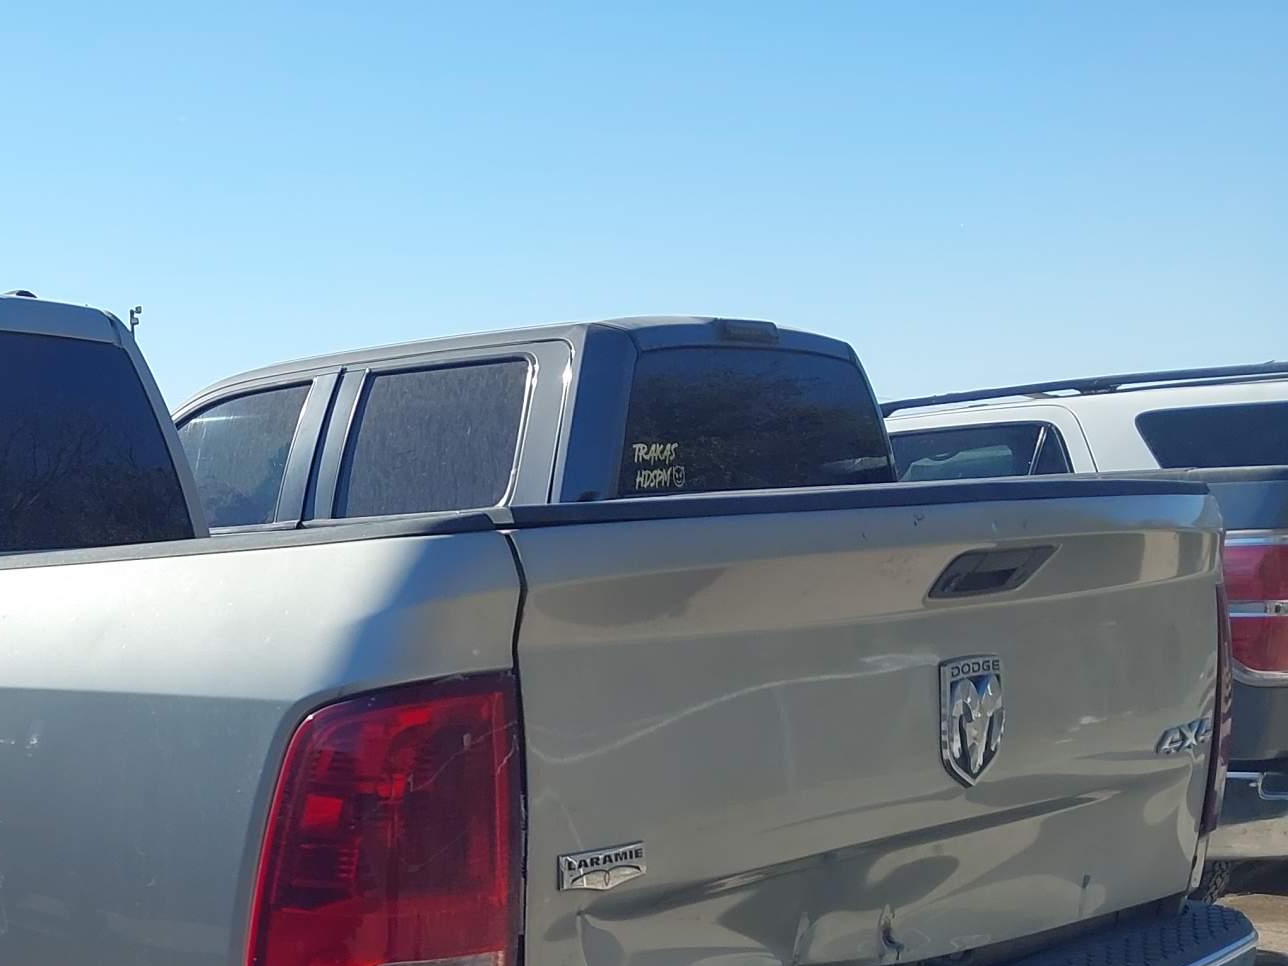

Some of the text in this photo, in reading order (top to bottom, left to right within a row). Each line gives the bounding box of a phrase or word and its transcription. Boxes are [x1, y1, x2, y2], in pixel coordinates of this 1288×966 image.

[632, 442, 679, 466] TRAKAS
[951, 660, 1001, 678] DODGE
[567, 848, 644, 871] LARAMIE
